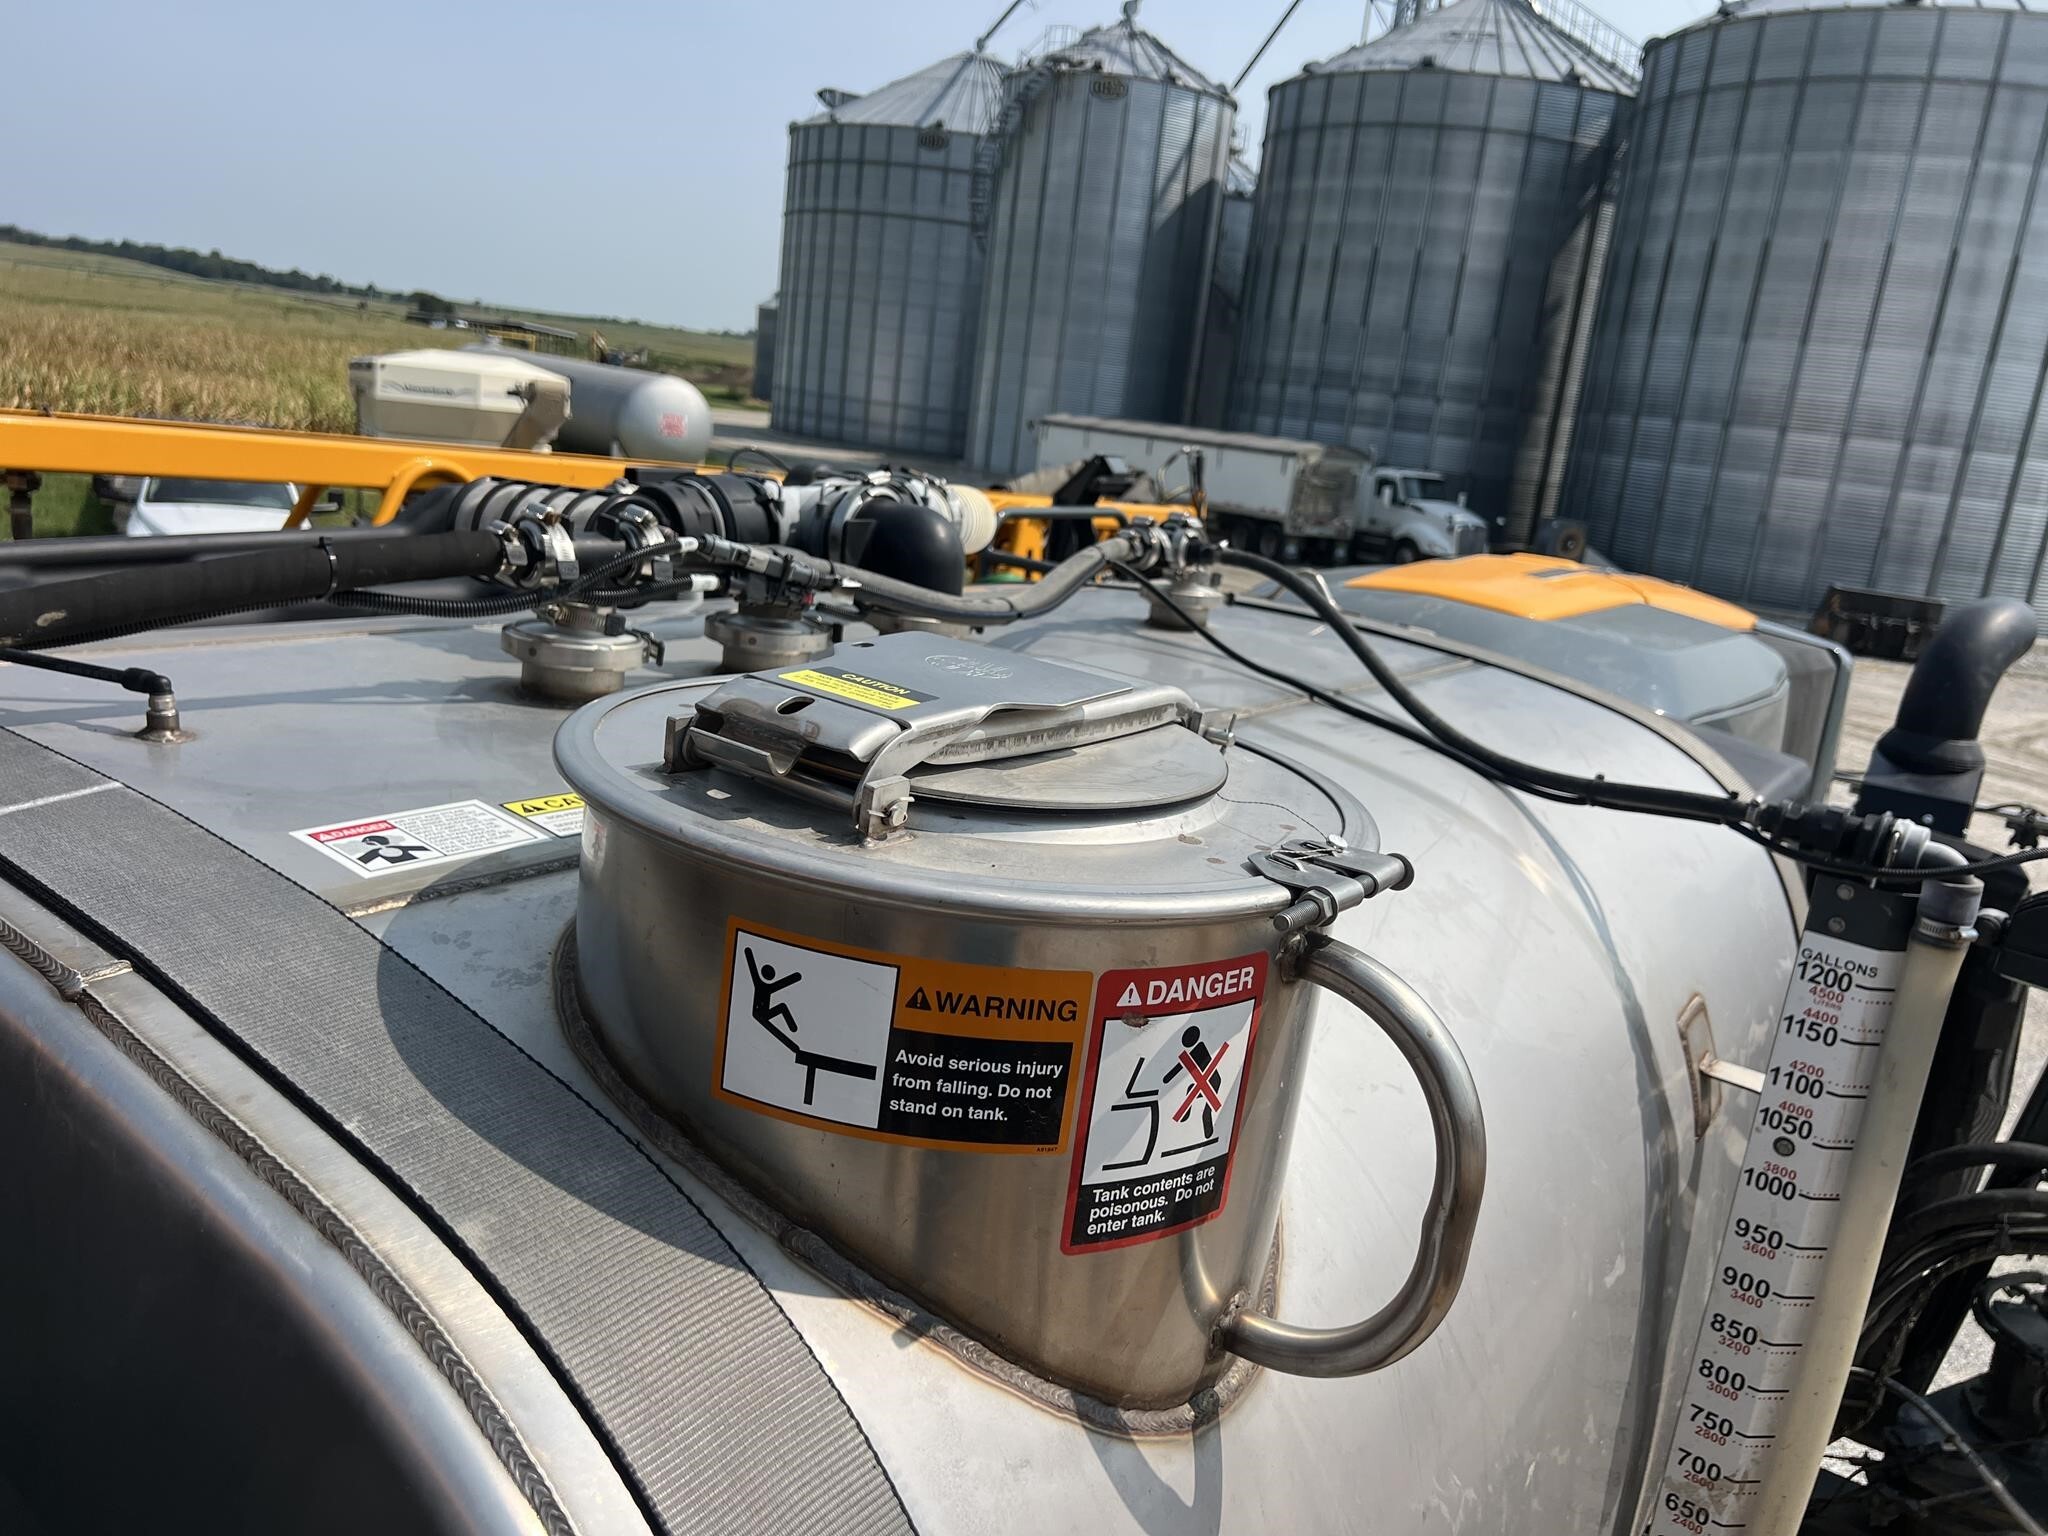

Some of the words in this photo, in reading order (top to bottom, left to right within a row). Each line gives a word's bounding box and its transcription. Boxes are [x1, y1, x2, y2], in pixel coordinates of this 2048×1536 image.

[842, 673, 910, 695] CAUTION
[1797, 961, 1853, 993] 1200
[1801, 948, 1879, 978] GALLONS
[1146, 966, 1255, 1006] DANGER
[1809, 985, 1844, 1003] 4500
[935, 990, 1078, 1022] WARNING
[1803, 1007, 1839, 1025] 4400
[1783, 1014, 1838, 1047] 1150
[894, 1049, 944, 1069] Avoid
[948, 1057, 1013, 1074] serious
[1016, 1060, 1063, 1078] injury
[1789, 1060, 1824, 1078] 4200
[891, 1073, 932, 1091] from
[936, 1078, 993, 1098] falling.
[997, 1083, 1021, 1099] Do
[1025, 1085, 1053, 1100] not
[1770, 1066, 1824, 1099] 1100
[889, 1098, 937, 1116] stand
[941, 1104, 963, 1118] on
[967, 1104, 1009, 1121] tank.
[1759, 1107, 1813, 1140] 1050
[1778, 1100, 1813, 1119] 4000
[1093, 1183, 1129, 1203] Tank
[1133, 1172, 1193, 1198] contents
[1196, 1165, 1215, 1181] are
[1744, 1167, 1796, 1201] 1000
[1763, 1161, 1797, 1181] 3800
[1089, 1196, 1169, 1221] poisonous.
[1175, 1187, 1193, 1203] Do
[1195, 1178, 1214, 1197] not
[1087, 1215, 1128, 1236] enter
[1132, 1210, 1165, 1228] tank.
[1734, 1217, 1783, 1250] 950
[1742, 1240, 1776, 1260] 3600
[1722, 1266, 1770, 1299] 900
[1730, 1289, 1763, 1308] 3400
[1710, 1313, 1758, 1345] 850
[1718, 1335, 1751, 1356] 3200
[1699, 1358, 1746, 1392] 800
[1706, 1380, 1739, 1401] 3000
[1690, 1403, 1733, 1437] 750
[1694, 1425, 1727, 1446] 2800
[1678, 1448, 1721, 1482] 700
[1683, 1470, 1715, 1491] 2600
[1665, 1493, 1710, 1525] 650
[1672, 1514, 1703, 1535] 2400
